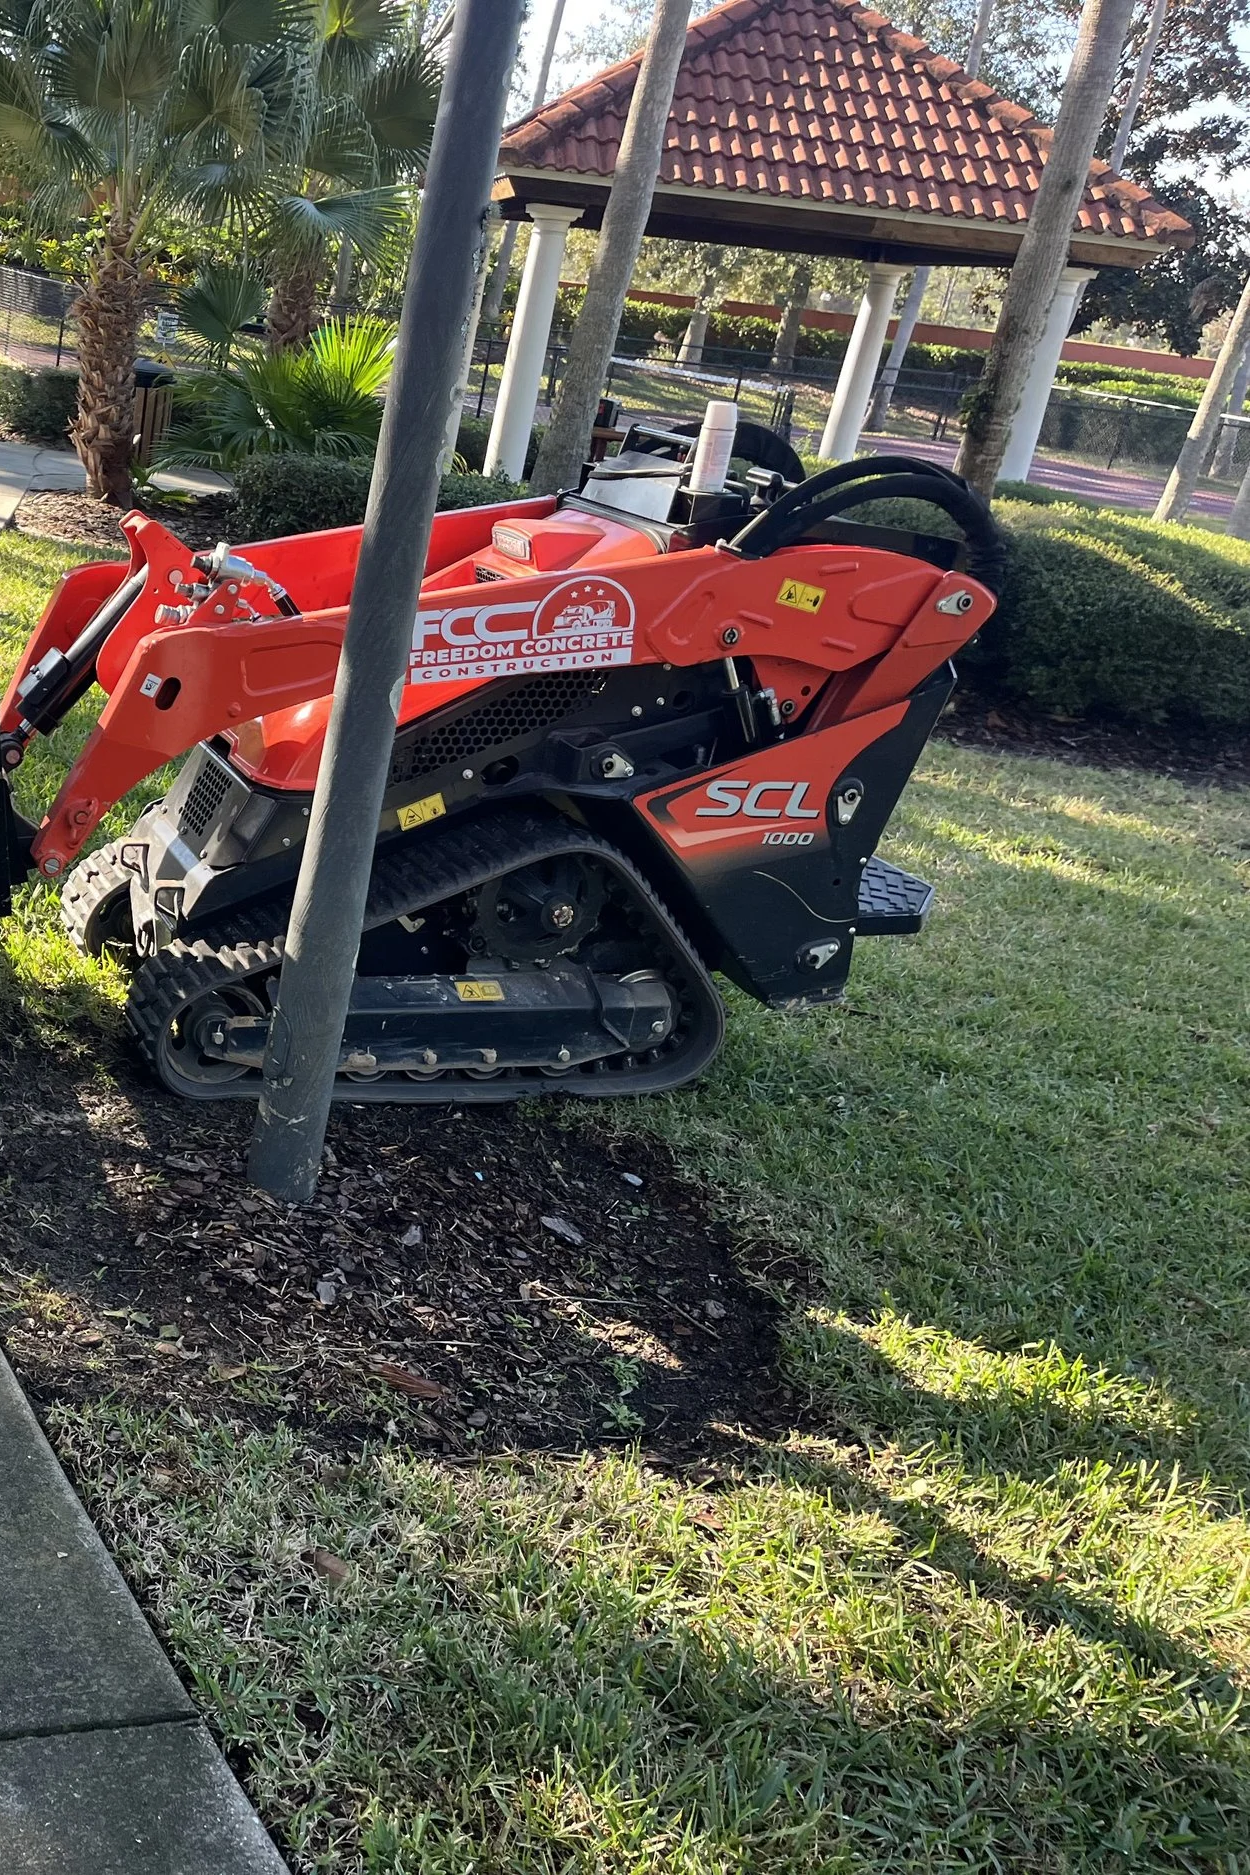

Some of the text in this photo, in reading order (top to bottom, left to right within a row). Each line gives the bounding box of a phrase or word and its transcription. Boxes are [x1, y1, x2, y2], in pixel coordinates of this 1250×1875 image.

[411, 600, 541, 650] FCC
[409, 630, 634, 667] FREEDOM CONCRETE
[421, 652, 614, 680] CONSTRUCTION
[695, 780, 821, 819] SCL
[761, 831, 816, 846] 1000
